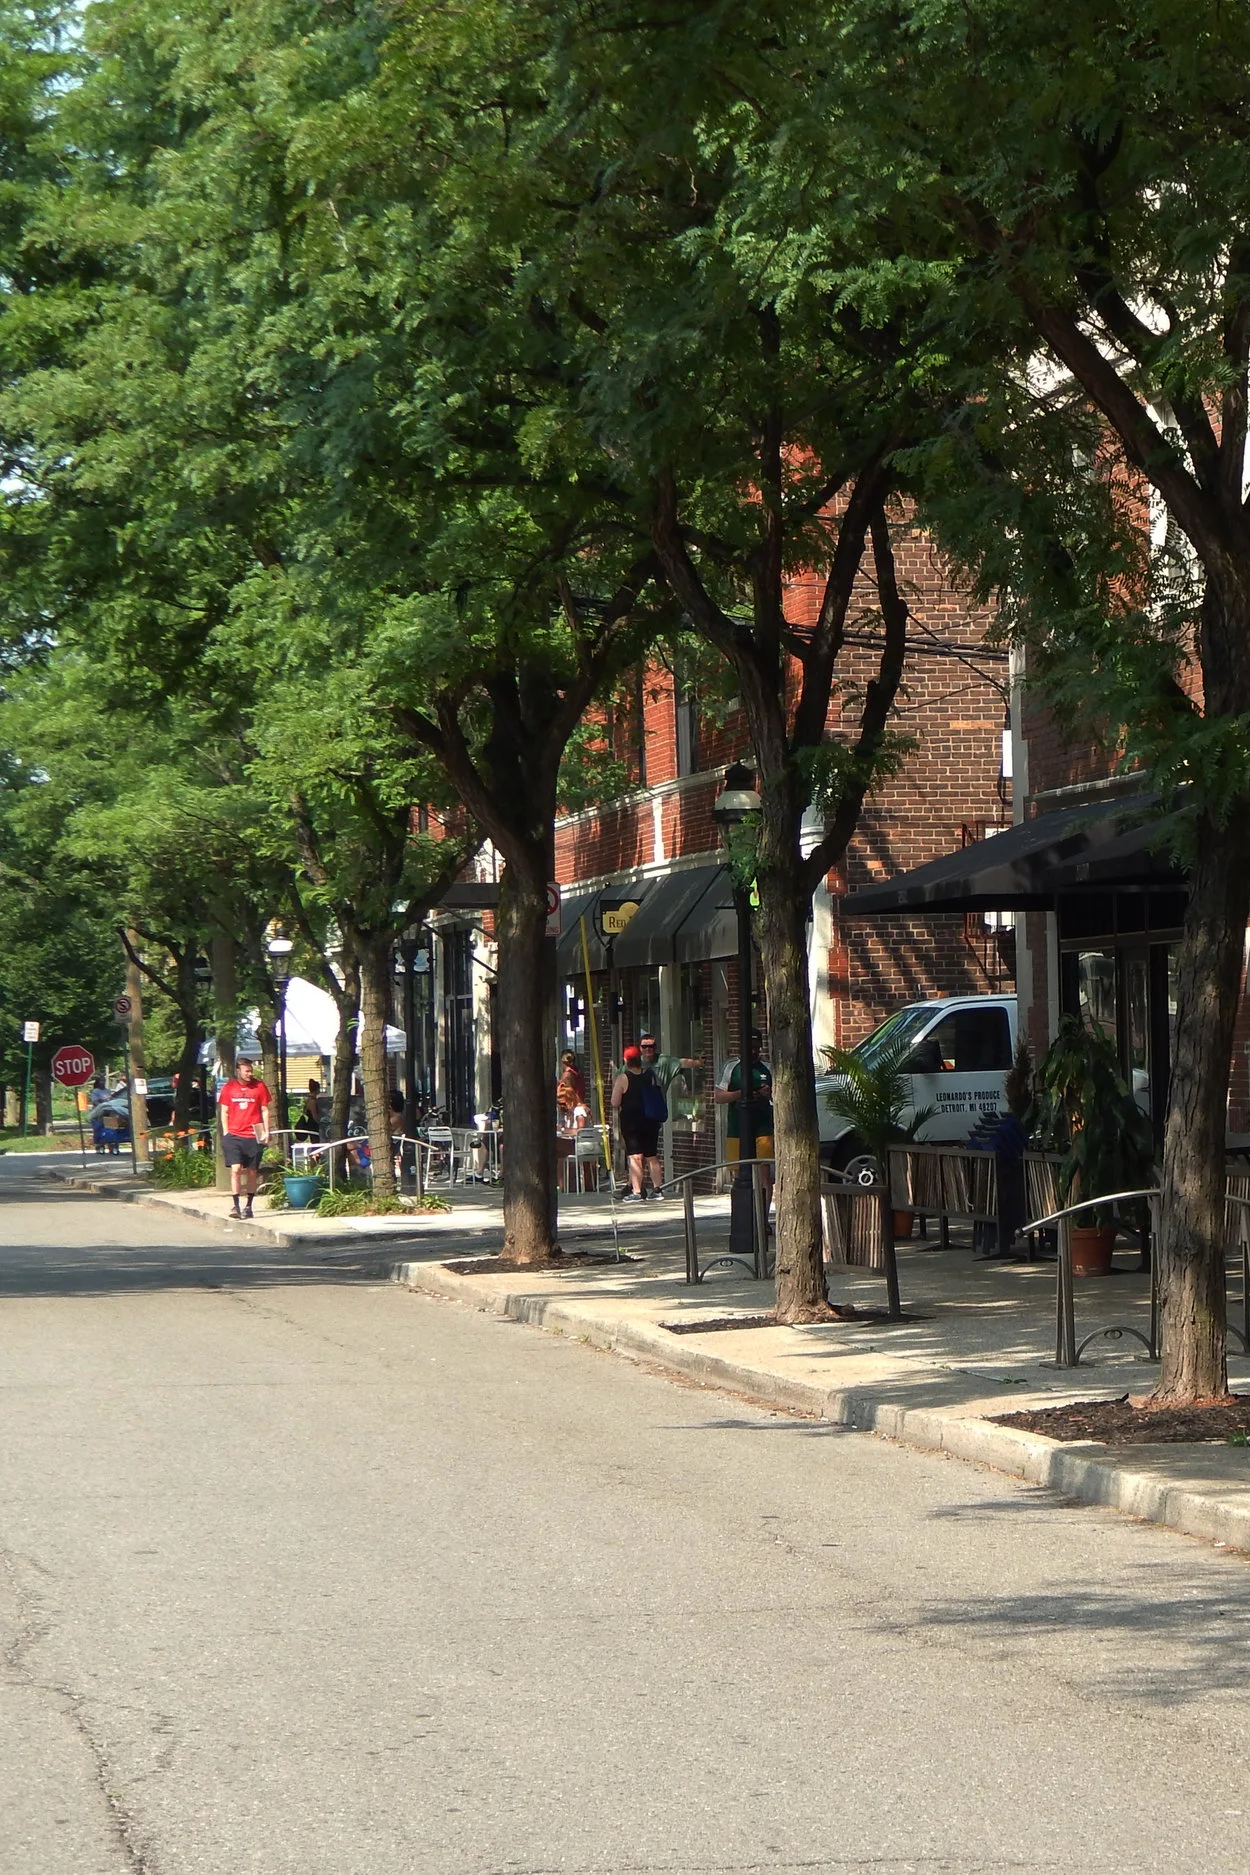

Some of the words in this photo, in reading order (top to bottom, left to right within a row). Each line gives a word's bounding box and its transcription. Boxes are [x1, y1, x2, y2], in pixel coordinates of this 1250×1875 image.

[55, 1057, 91, 1076] STOP
[936, 1091, 972, 1102] LEONARDO'S
[974, 1090, 1000, 1100] PRODUCE
[969, 1103, 977, 1112] MI
[979, 1102, 997, 1111] 48207
